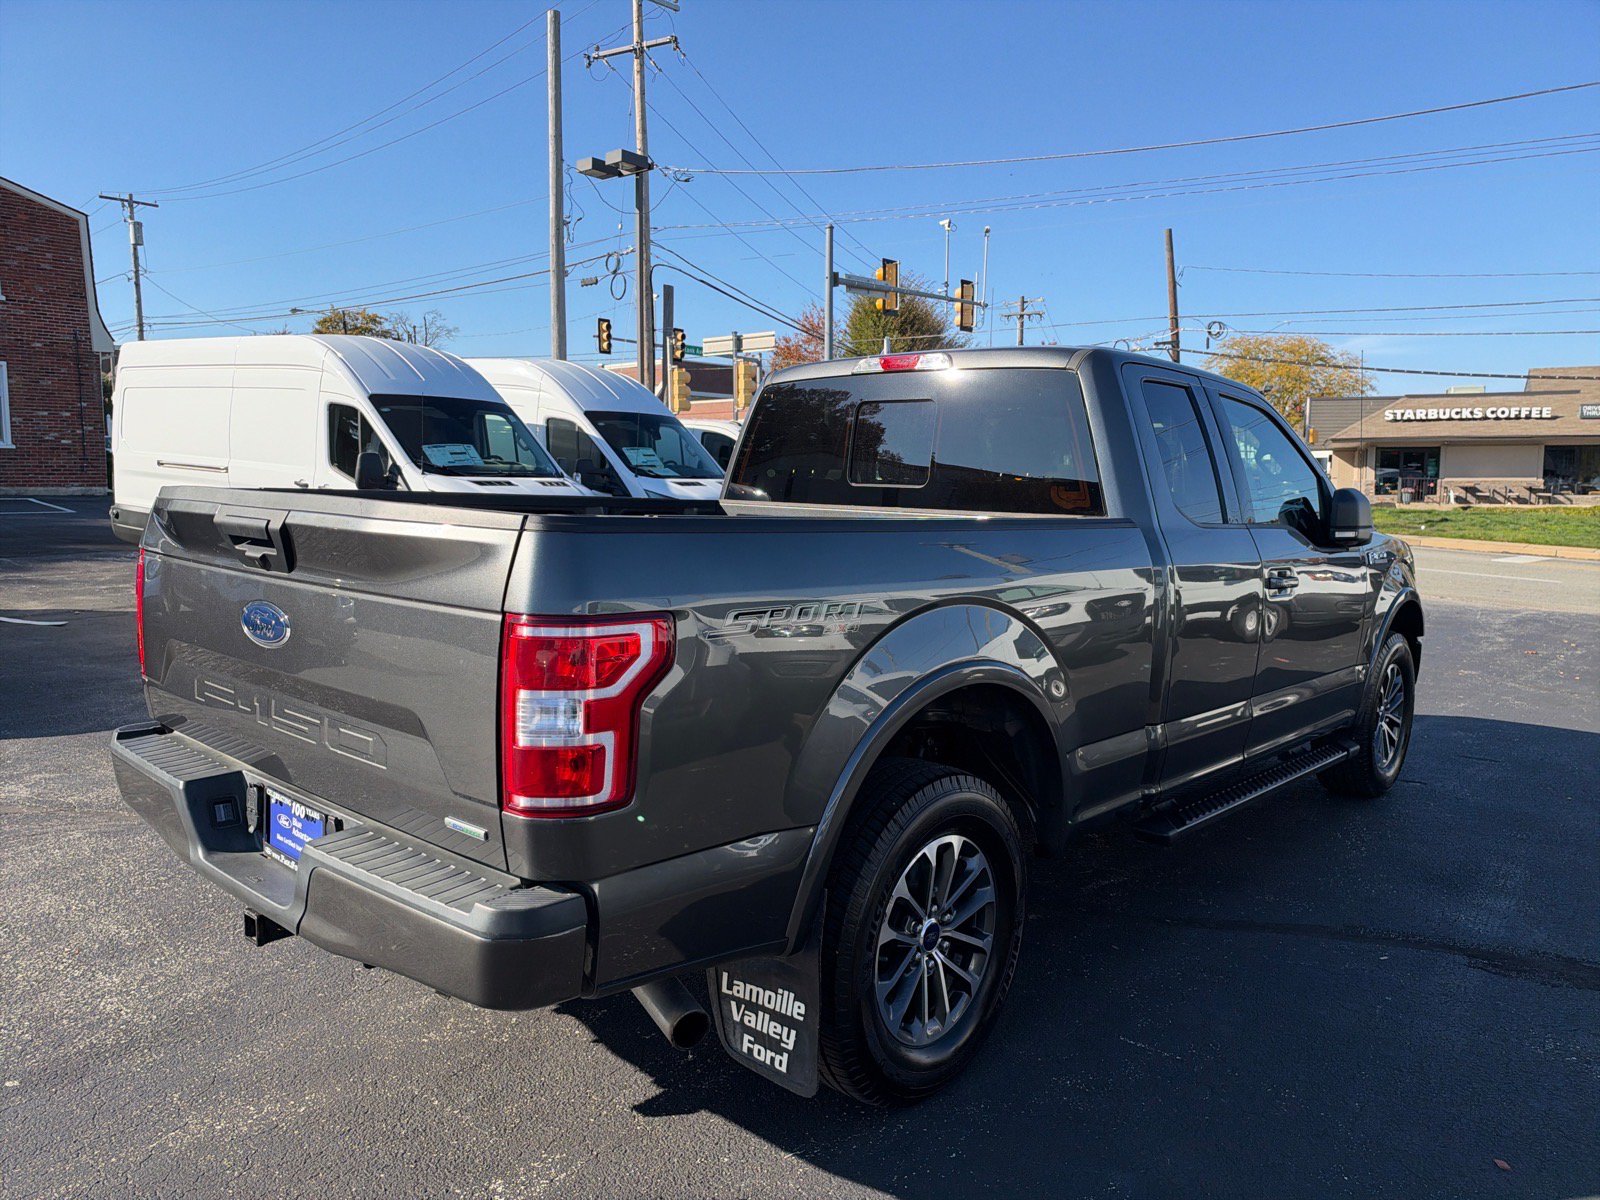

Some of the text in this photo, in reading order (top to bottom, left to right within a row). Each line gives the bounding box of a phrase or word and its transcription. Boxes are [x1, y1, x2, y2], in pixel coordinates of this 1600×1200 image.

[1384, 407, 1552, 420] STARBUCKS COFFEE
[705, 600, 878, 640] SPORT
[292, 802, 306, 819] 100
[721, 971, 806, 1022] Lamoille
[730, 1000, 797, 1051] Valley
[741, 1033, 789, 1073] Ford
